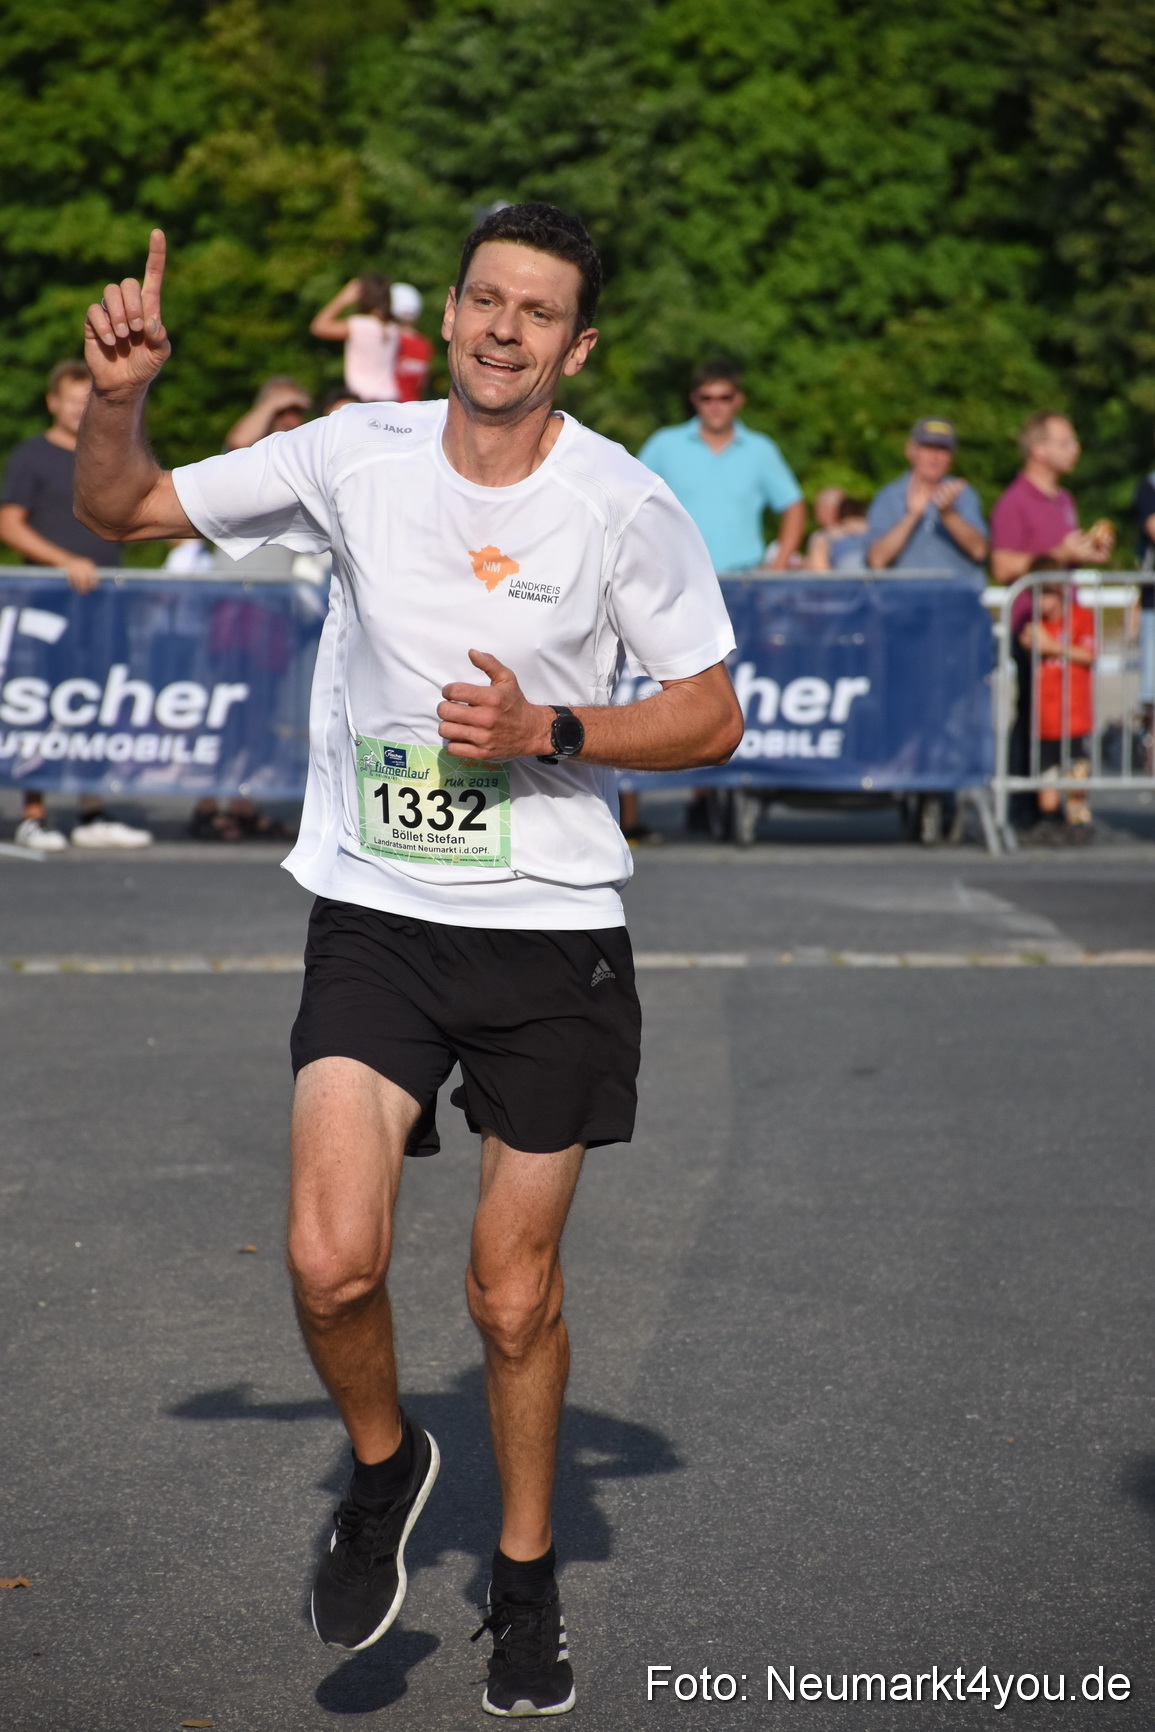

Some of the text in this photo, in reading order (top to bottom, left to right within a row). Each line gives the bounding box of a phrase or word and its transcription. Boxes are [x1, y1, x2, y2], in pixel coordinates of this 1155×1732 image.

[383, 423, 413, 434] JAKO
[482, 561, 501, 573] NM
[509, 579, 561, 595] LANDKREIS
[508, 588, 560, 605] NEUMARKT
[0, 663, 249, 729] scher
[730, 661, 871, 725] her
[733, 728, 843, 759] OBILE
[375, 761, 430, 780] firmenlauf
[468, 778, 499, 788] 2019
[374, 782, 487, 832] 1332
[373, 836, 416, 851] Landratsamt
[418, 845, 457, 854] Neumarkt
[392, 828, 466, 845] Böllet Stefan
